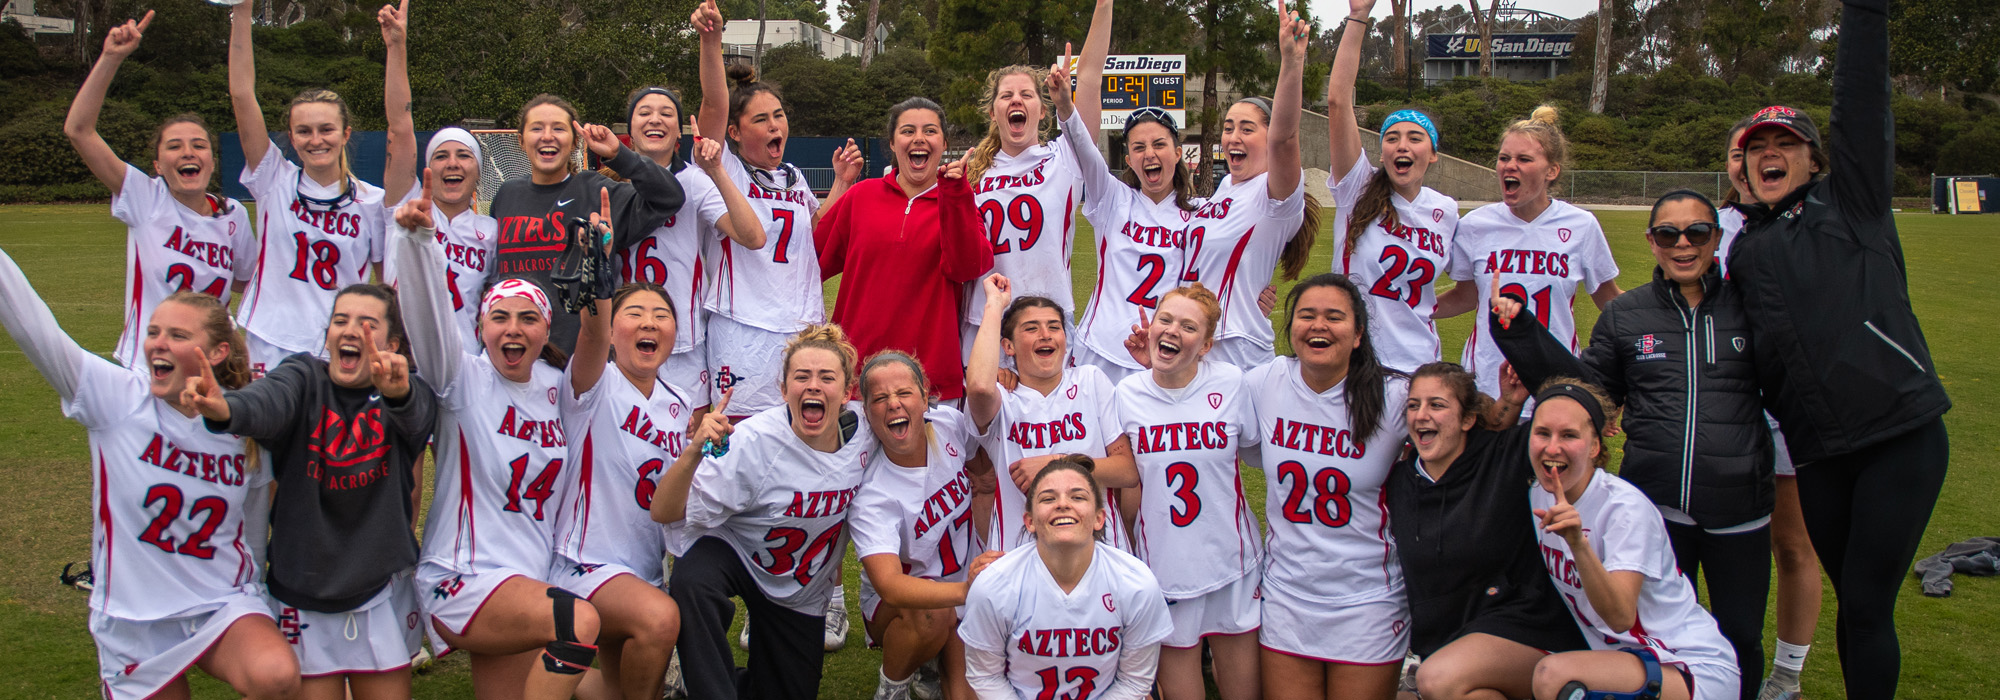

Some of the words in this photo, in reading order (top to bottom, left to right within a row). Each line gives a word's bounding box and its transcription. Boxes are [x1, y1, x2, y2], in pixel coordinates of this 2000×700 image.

[1108, 76, 1144, 92] 0:24
[1130, 93, 1139, 106] 4
[1153, 77, 1180, 85] GUEST
[1162, 90, 1176, 106] 15
[498, 211, 566, 245] ZTECS
[772, 208, 794, 263] 7
[979, 193, 1044, 255] 29
[1121, 220, 1184, 250] AZTEC
[289, 231, 341, 290] 18
[1126, 253, 1166, 309] 2
[1370, 244, 1435, 310] 23
[1484, 249, 1569, 278] AZTECS
[1007, 412, 1086, 449] AZTECS
[1137, 421, 1228, 454] AZTECS
[1271, 417, 1366, 459] AZTECS
[139, 432, 246, 487] AZTECS
[635, 458, 664, 511] 6
[503, 453, 563, 521] 14
[1165, 461, 1202, 527] 3
[1277, 460, 1351, 528] 28
[138, 482, 229, 560] 22
[937, 502, 973, 577] 17
[752, 519, 845, 587] 30
[1018, 626, 1121, 657] AZTECS
